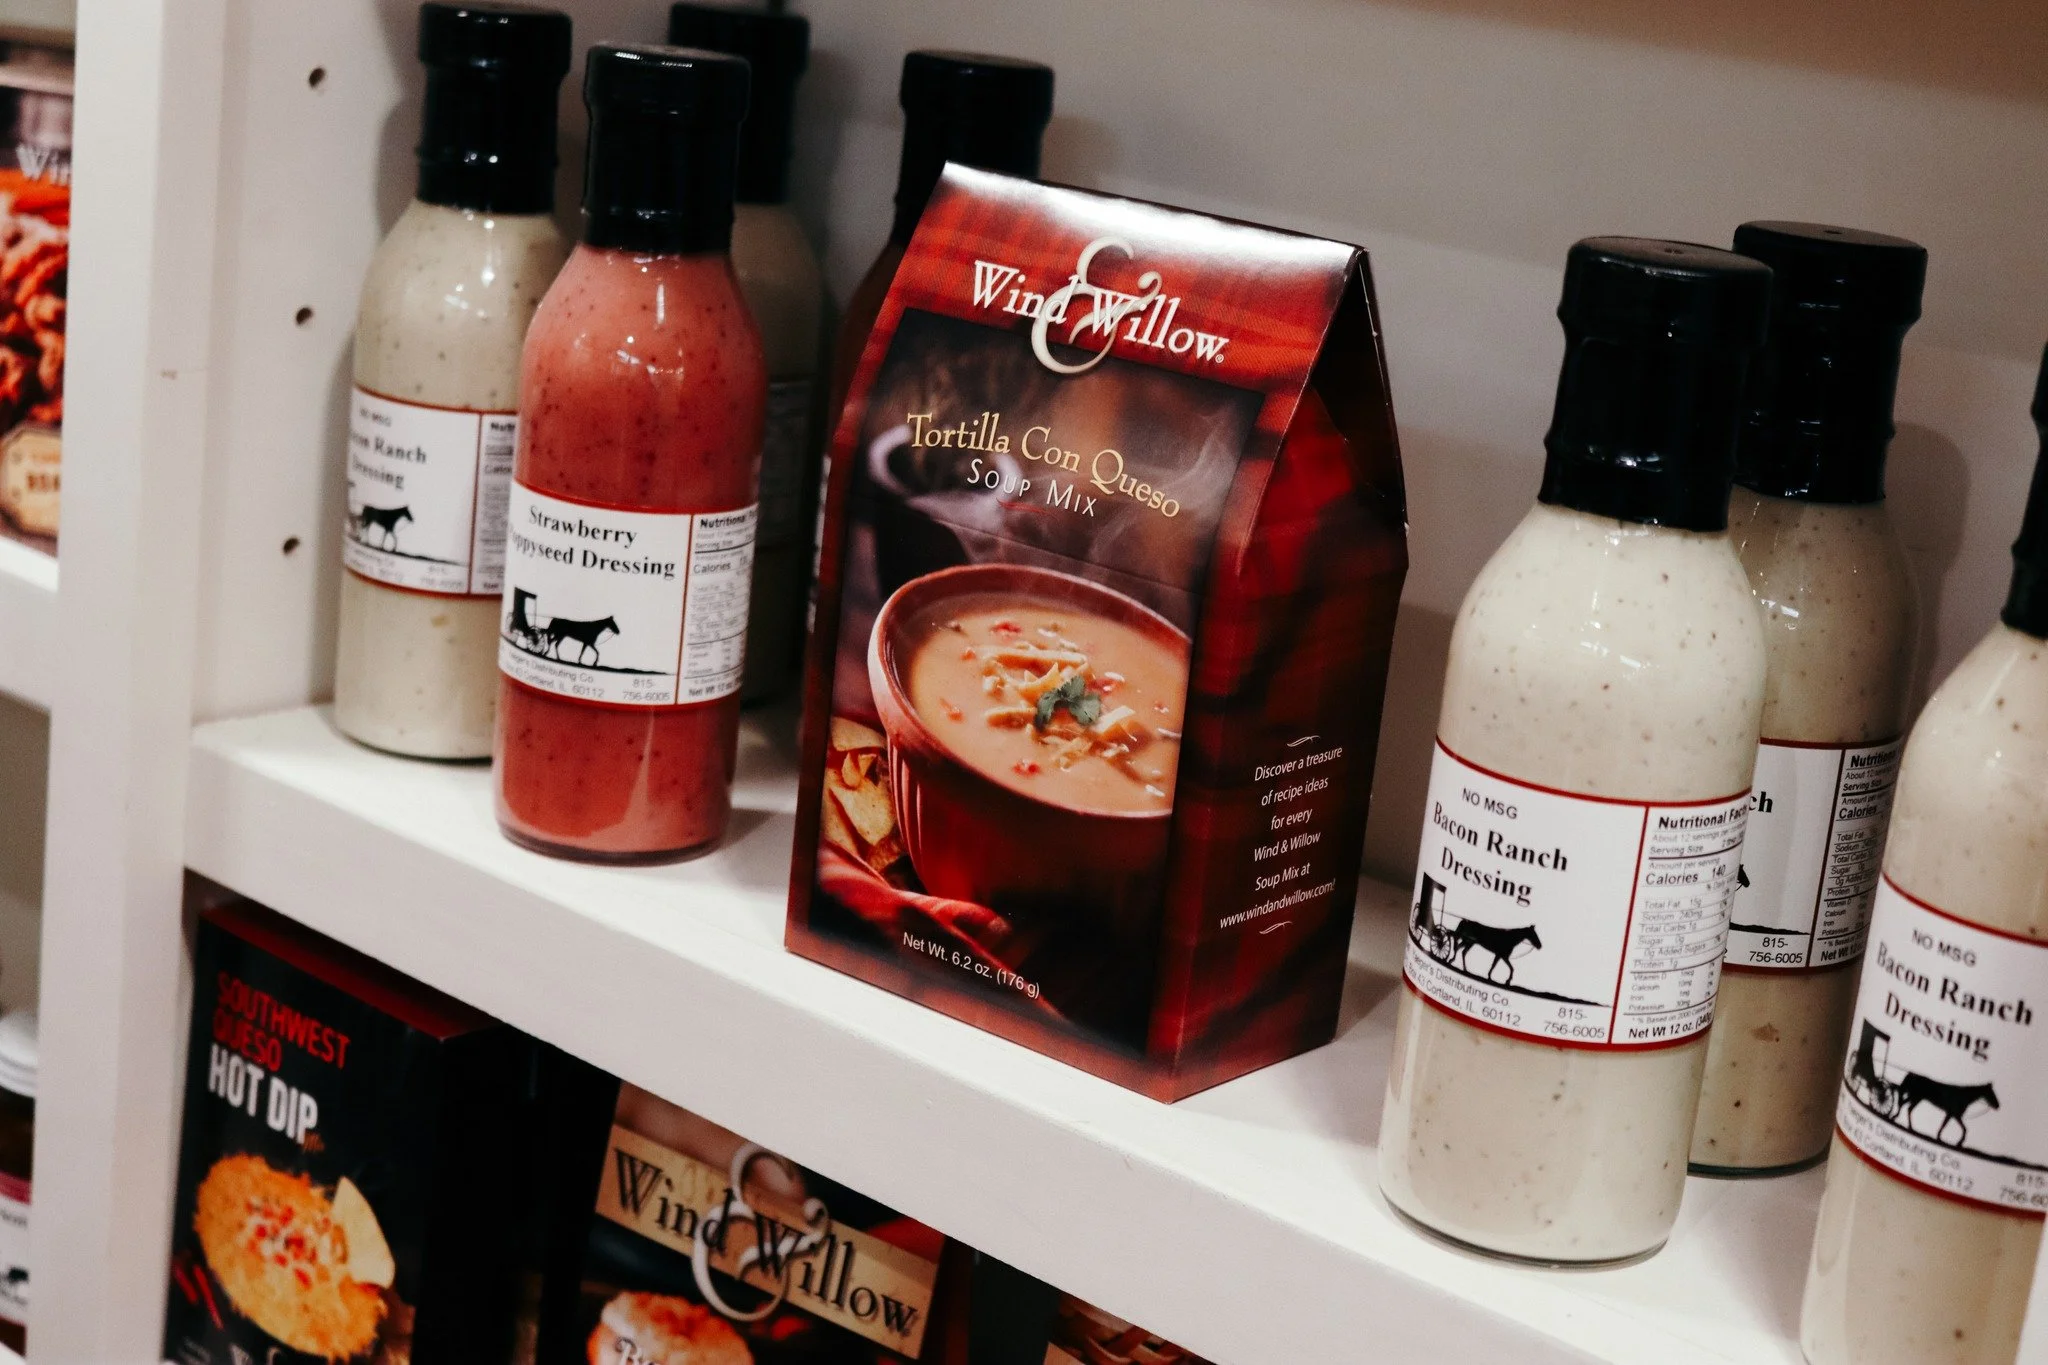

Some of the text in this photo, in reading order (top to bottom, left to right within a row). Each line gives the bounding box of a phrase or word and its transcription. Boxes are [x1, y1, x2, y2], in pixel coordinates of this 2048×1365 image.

[972, 259, 1080, 325] Wind
[1031, 236, 1162, 374] &
[374, 436, 427, 463] Ranch
[907, 411, 1180, 517] Tortilla Con Queso
[529, 505, 637, 549] Strawberry
[582, 549, 676, 581] Dressing
[693, 562, 731, 574] Calories
[572, 685, 605, 699] 60112
[1254, 747, 1343, 781] Discover a treasure
[1261, 776, 1329, 806] of recipe ideas
[1843, 782, 1869, 791] Serving
[1462, 787, 1518, 820] NO MSG
[1842, 795, 1867, 805] Amount
[1271, 808, 1313, 830] for every
[1658, 811, 1727, 829] Nutritional
[1839, 804, 1877, 819] Calories
[1254, 831, 1321, 862] Wind & Willow
[1433, 801, 1568, 872] Bacon Ranch
[1836, 832, 1853, 841] Total
[1650, 845, 1704, 856] Serving Size
[1832, 854, 1849, 863] Total
[1254, 862, 1310, 891] Soup Mix at
[1441, 846, 1532, 908] Dressing
[1645, 872, 1698, 886] Calories
[1644, 900, 1665, 909] Total
[1667, 899, 1680, 908] Fat
[1642, 911, 1675, 920] Sodium
[1640, 923, 1660, 933] Total
[1663, 922, 1687, 932] Carbs
[1638, 935, 1663, 947] Sugar
[1658, 946, 1682, 955] Added
[1762, 936, 1789, 948] 815-
[1912, 929, 1977, 967] NO MSG
[903, 931, 1040, 999] Net Wt. 6.2 oz. (176 g)
[1633, 959, 1664, 969] Protein
[1749, 950, 1803, 964] 756-6005
[1820, 949, 1837, 961] Net
[1436, 967, 1489, 1003] Distributing
[1631, 984, 1660, 992] Calcium
[1877, 941, 2033, 1028] Bacon Ranch
[217, 970, 352, 1070] SOUTHWEST
[1482, 1006, 1521, 1027] 60112
[1558, 1006, 1588, 1020] 815-
[1543, 1020, 1605, 1039] 756-6005
[1628, 1028, 1649, 1039] Net
[1670, 1023, 1681, 1035] 12
[1885, 990, 1991, 1063] Dressing
[213, 1006, 283, 1072] QUESO
[208, 1042, 318, 1146] HOT DIP
[1929, 1167, 1975, 1192] 60112
[615, 1147, 734, 1257] Wind
[753, 1211, 918, 1338] Willow
